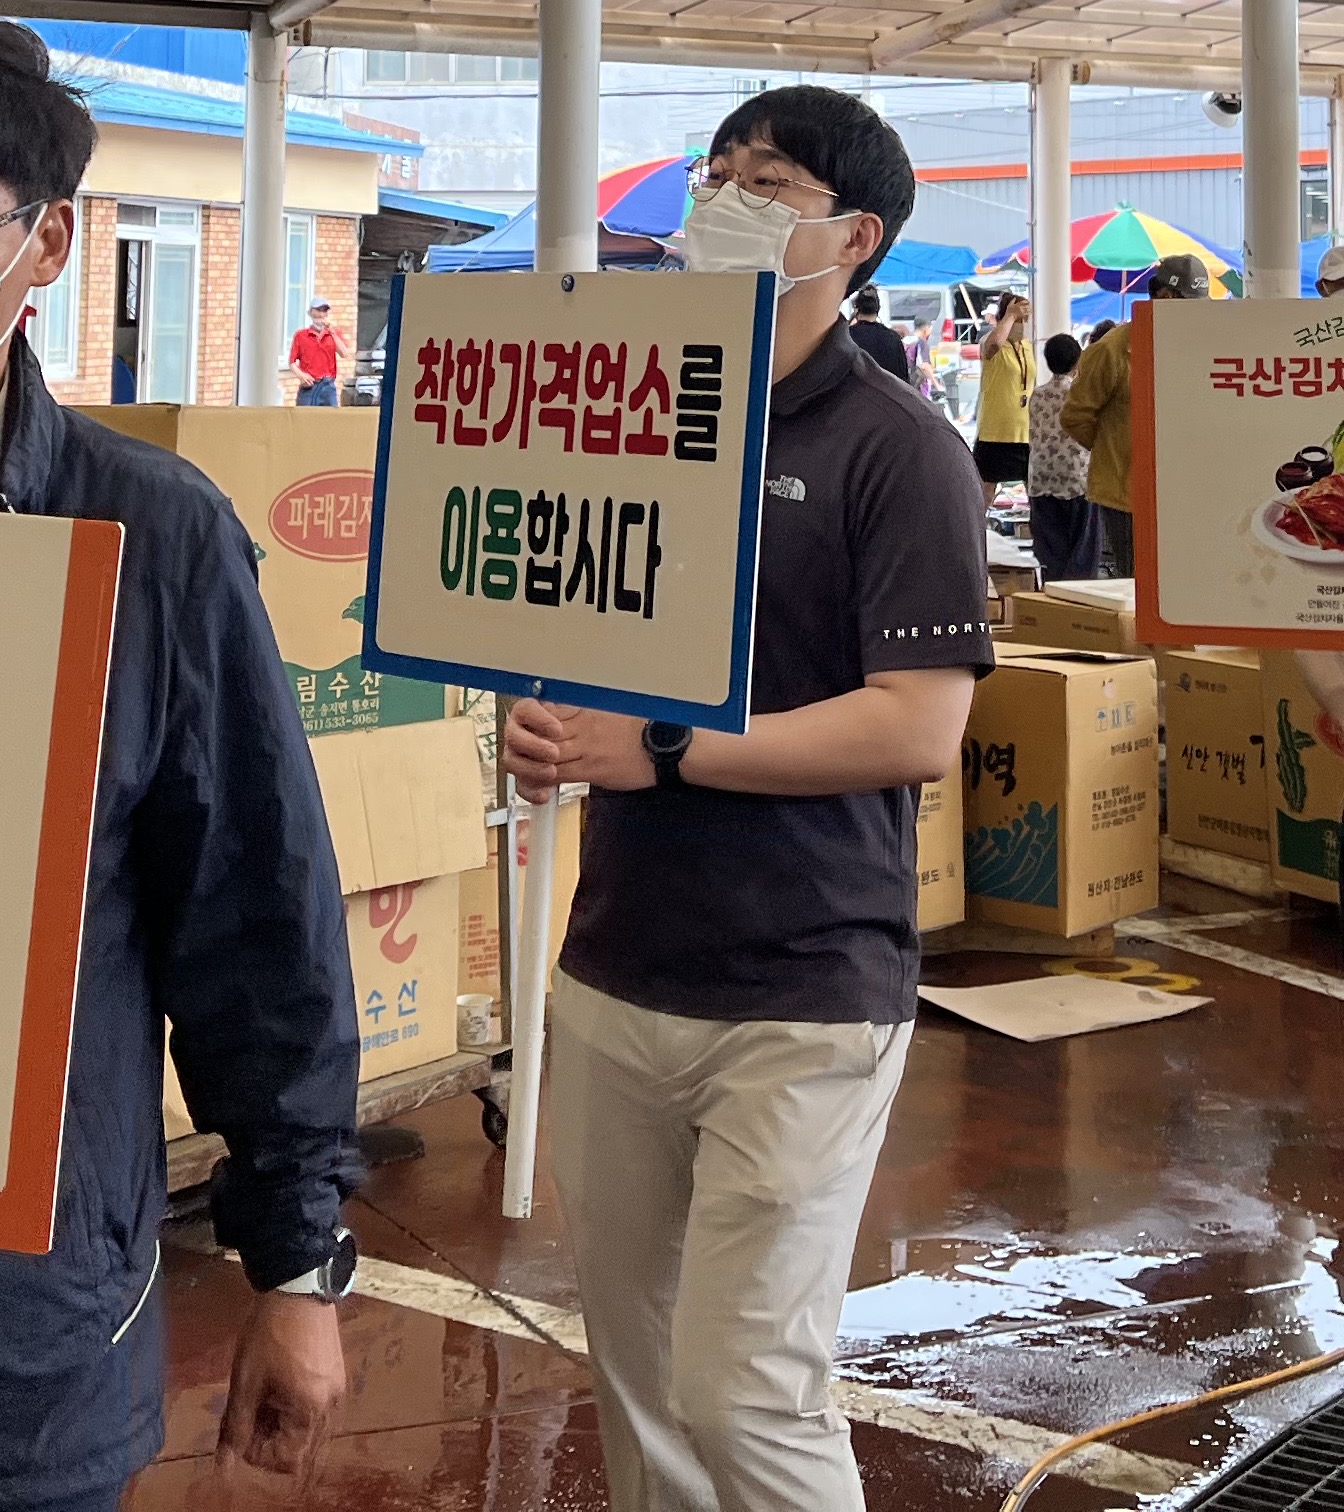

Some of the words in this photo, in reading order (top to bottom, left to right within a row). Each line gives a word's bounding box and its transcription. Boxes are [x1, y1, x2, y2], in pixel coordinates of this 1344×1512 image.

[413, 336, 724, 463] 착한가격업소를
[439, 484, 662, 621] 이용합시다
[883, 626, 920, 640] THE
